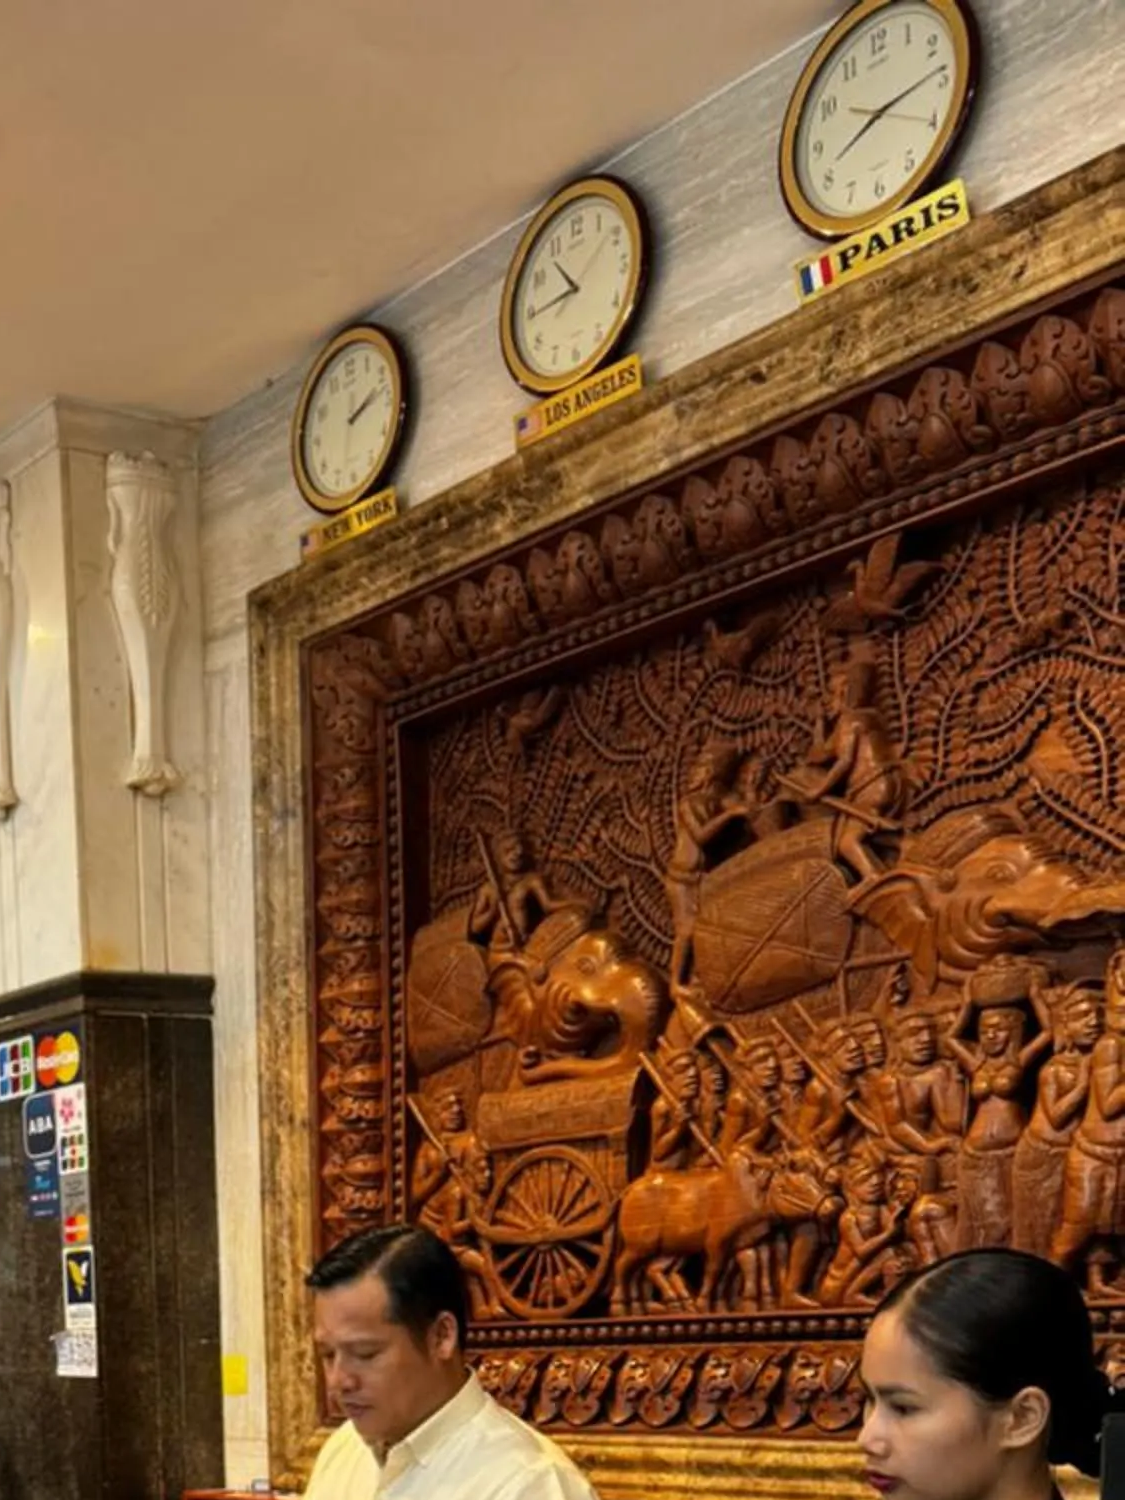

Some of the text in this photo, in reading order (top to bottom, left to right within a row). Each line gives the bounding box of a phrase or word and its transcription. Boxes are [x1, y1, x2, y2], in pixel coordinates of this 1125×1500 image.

[869, 27, 887, 56] 12
[841, 56, 857, 82] 11
[819, 96, 837, 122] 10
[812, 140, 824, 161] 9
[904, 149, 916, 172] 5
[846, 180, 857, 205] 7
[874, 180, 885, 198] 6
[837, 193, 961, 273] PARIS
[543, 364, 638, 426] LOS ANGELES
[28, 1115, 54, 1136] ABA
